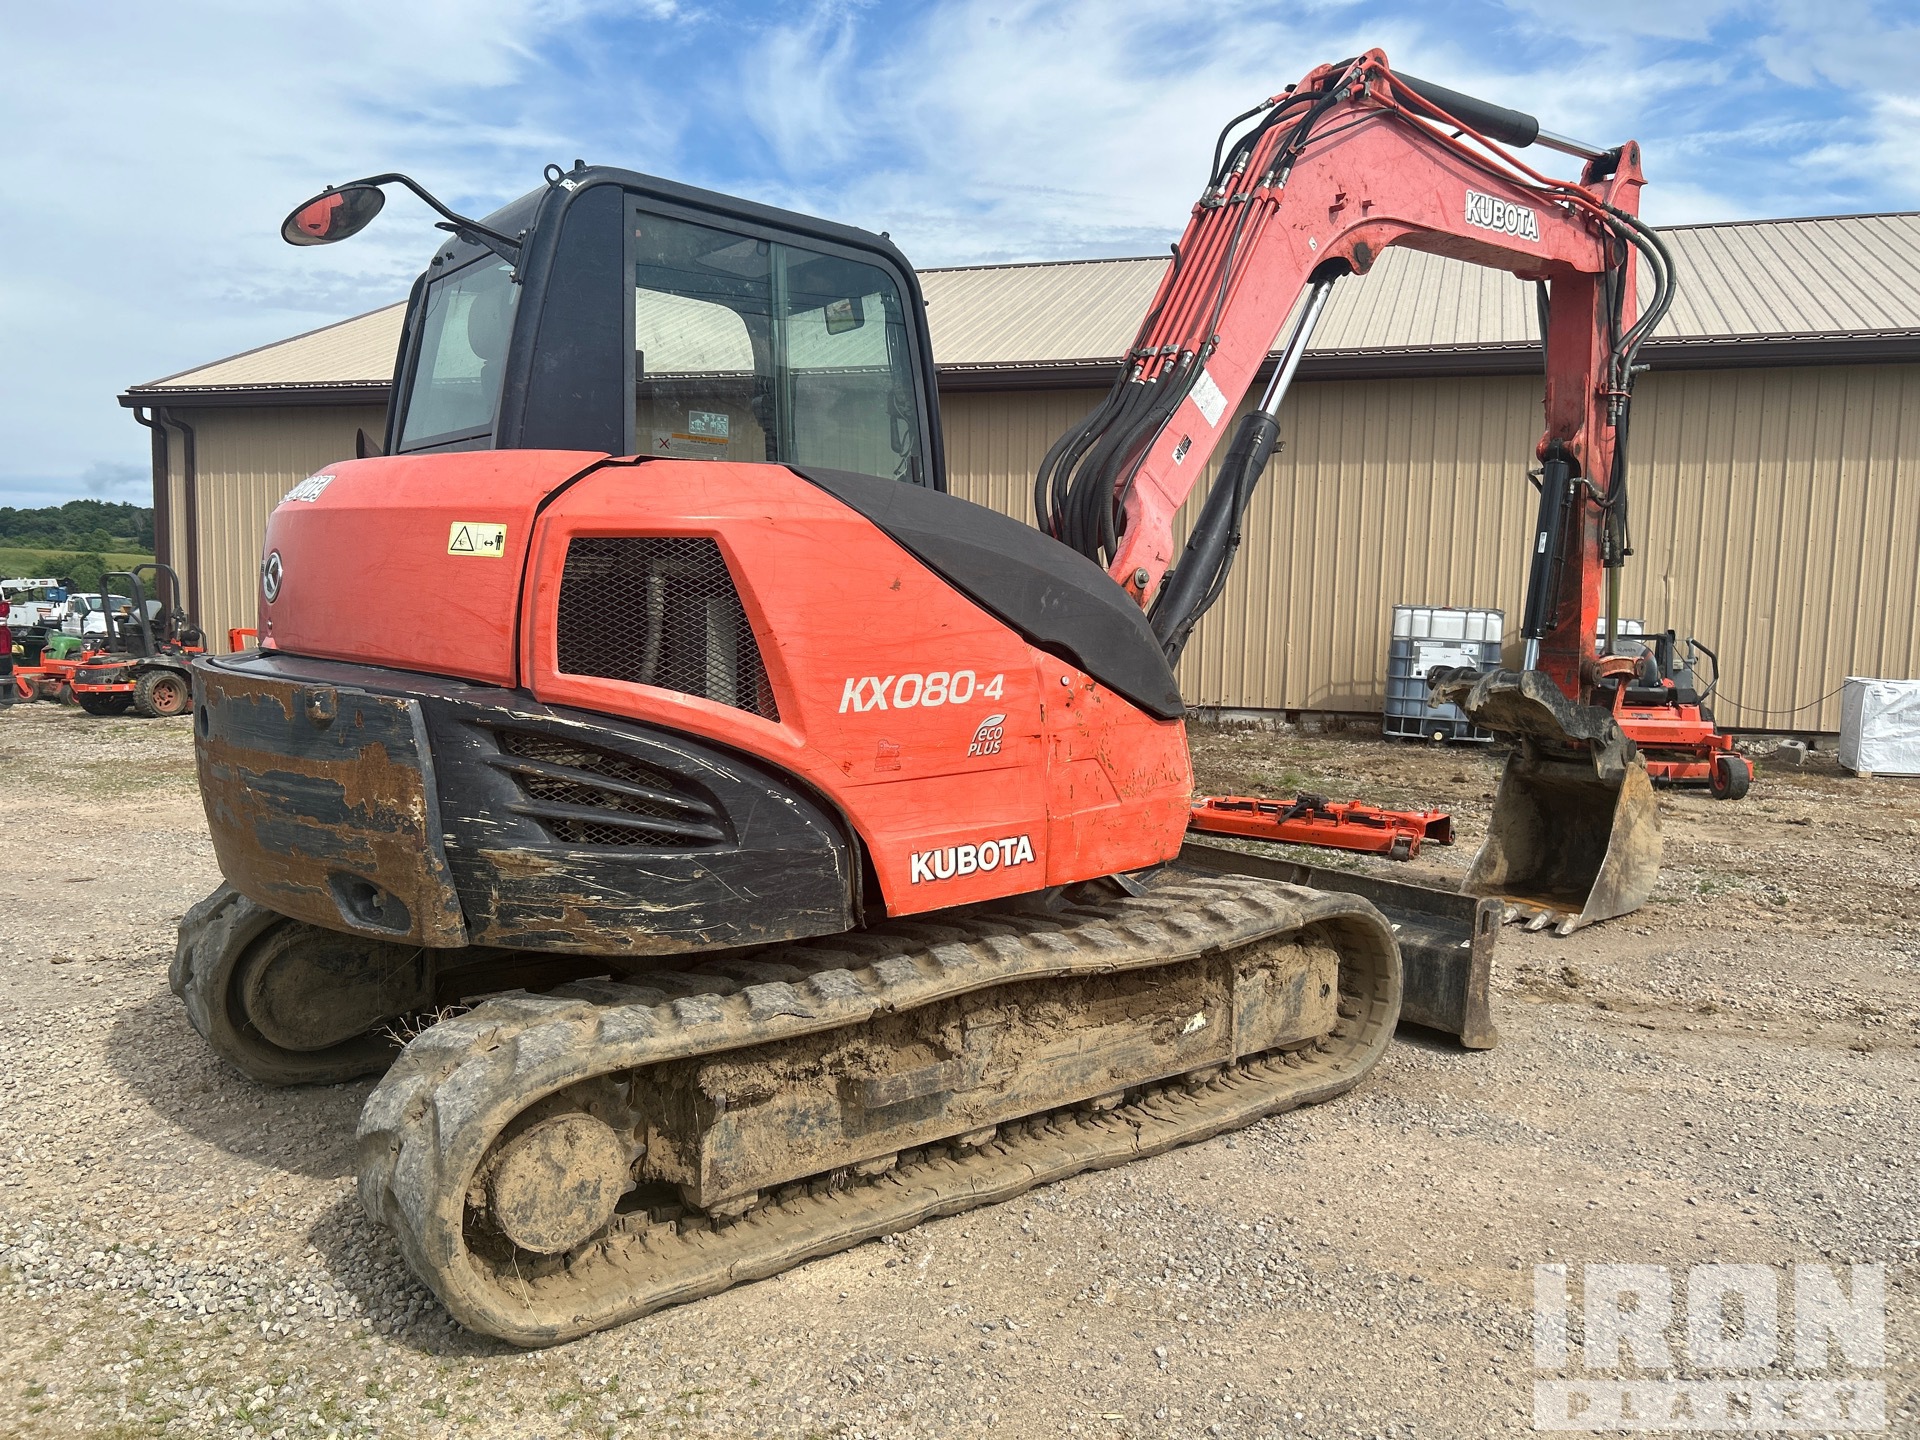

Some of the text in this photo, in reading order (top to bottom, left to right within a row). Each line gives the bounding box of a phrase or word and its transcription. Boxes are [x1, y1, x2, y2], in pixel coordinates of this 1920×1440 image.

[1466, 190, 1539, 241] KUBOTA
[838, 669, 1005, 713] KX080-4
[967, 740, 1002, 757] PLUS
[978, 726, 1003, 742] eco
[910, 834, 1035, 884] KUBOTA
